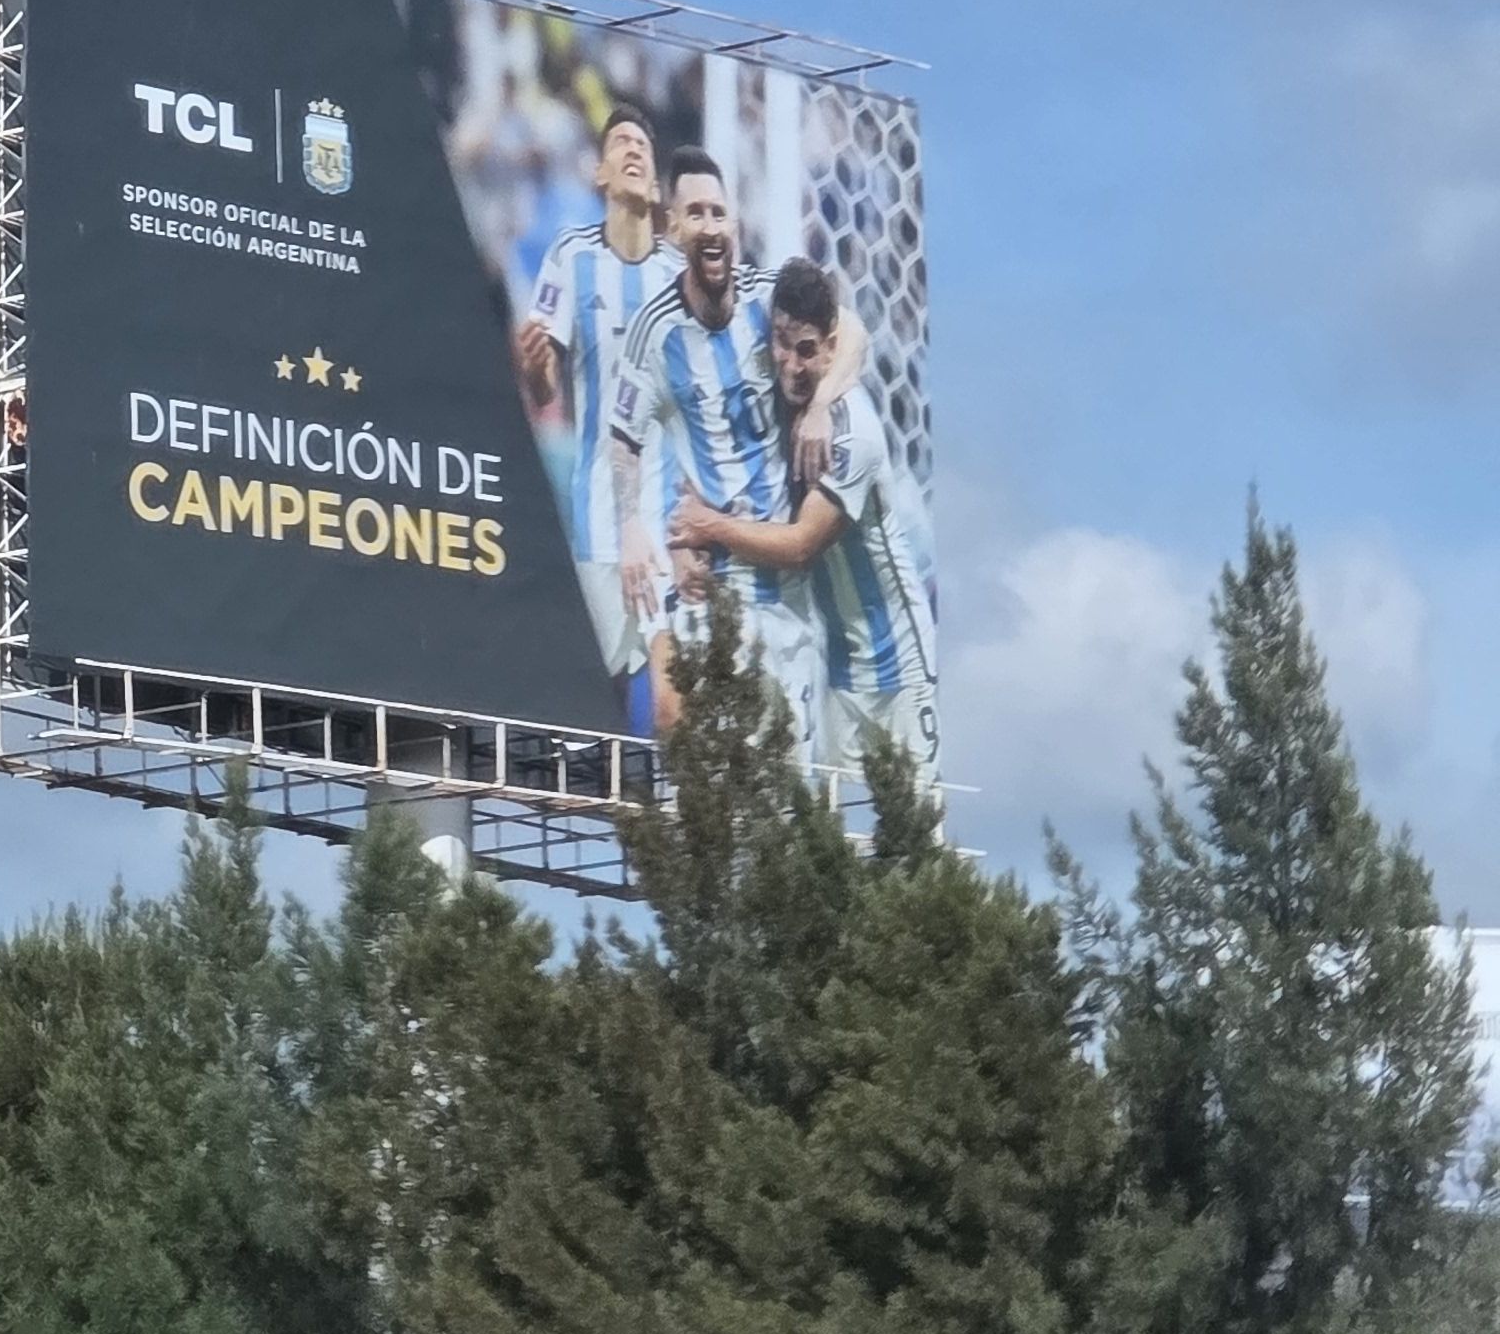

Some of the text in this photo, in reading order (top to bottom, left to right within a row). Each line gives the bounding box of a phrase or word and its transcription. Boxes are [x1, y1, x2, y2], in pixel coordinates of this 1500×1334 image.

[134, 83, 253, 152] TCL
[122, 183, 367, 247] SPONSOR OFICIAL DE LA
[129, 213, 361, 274] SELECCIÓN ARGENTINA
[129, 392, 504, 503] DEFINICIÓN DE
[127, 461, 507, 576] CAMPEONES
